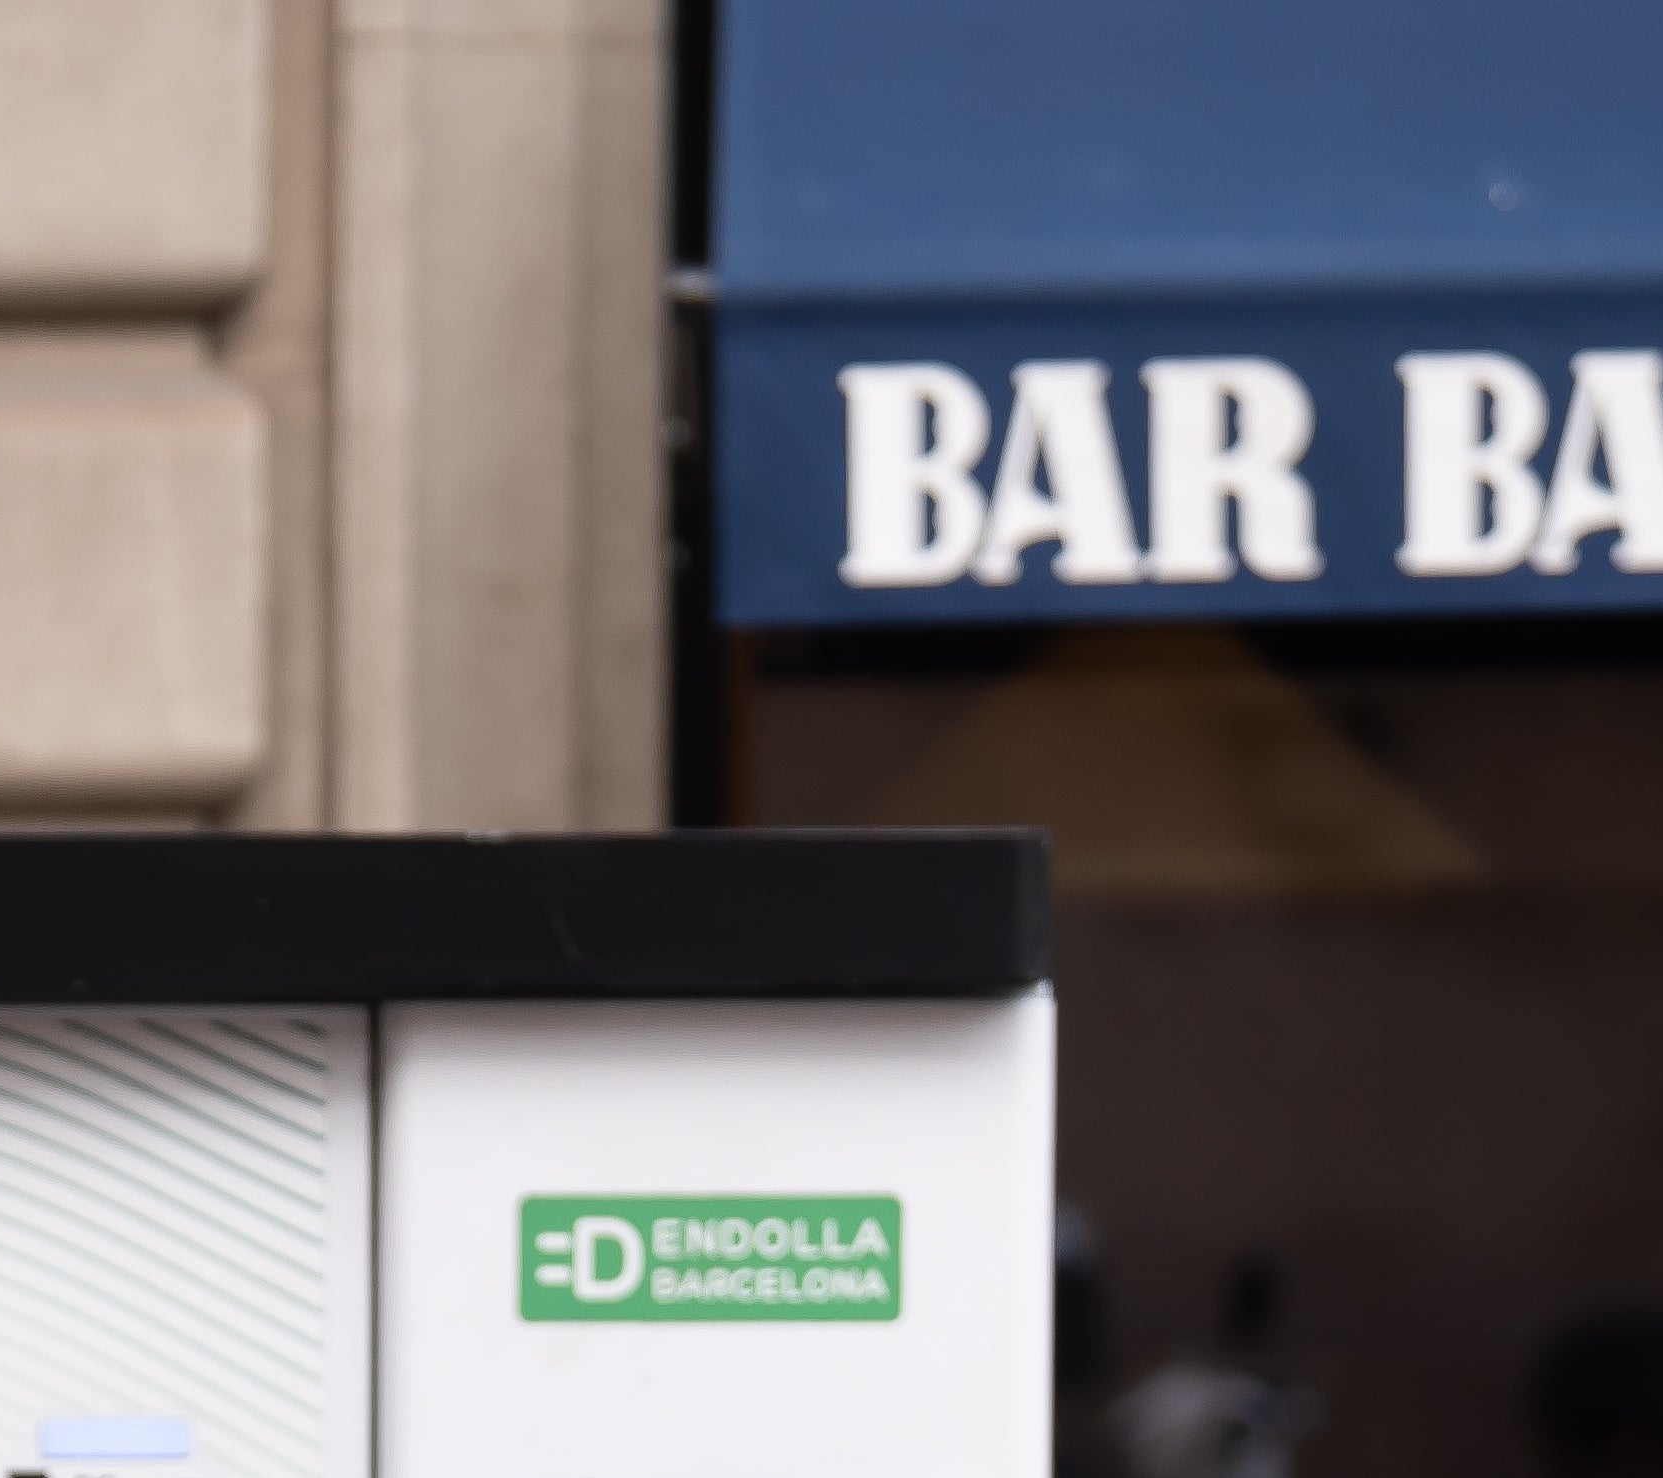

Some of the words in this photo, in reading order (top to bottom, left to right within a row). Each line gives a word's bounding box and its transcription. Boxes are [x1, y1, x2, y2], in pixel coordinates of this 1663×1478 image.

[837, 357, 1326, 589] BAR
[651, 1218, 889, 1260] ENDOLLA
[650, 1267, 889, 1303] BARCELONA
